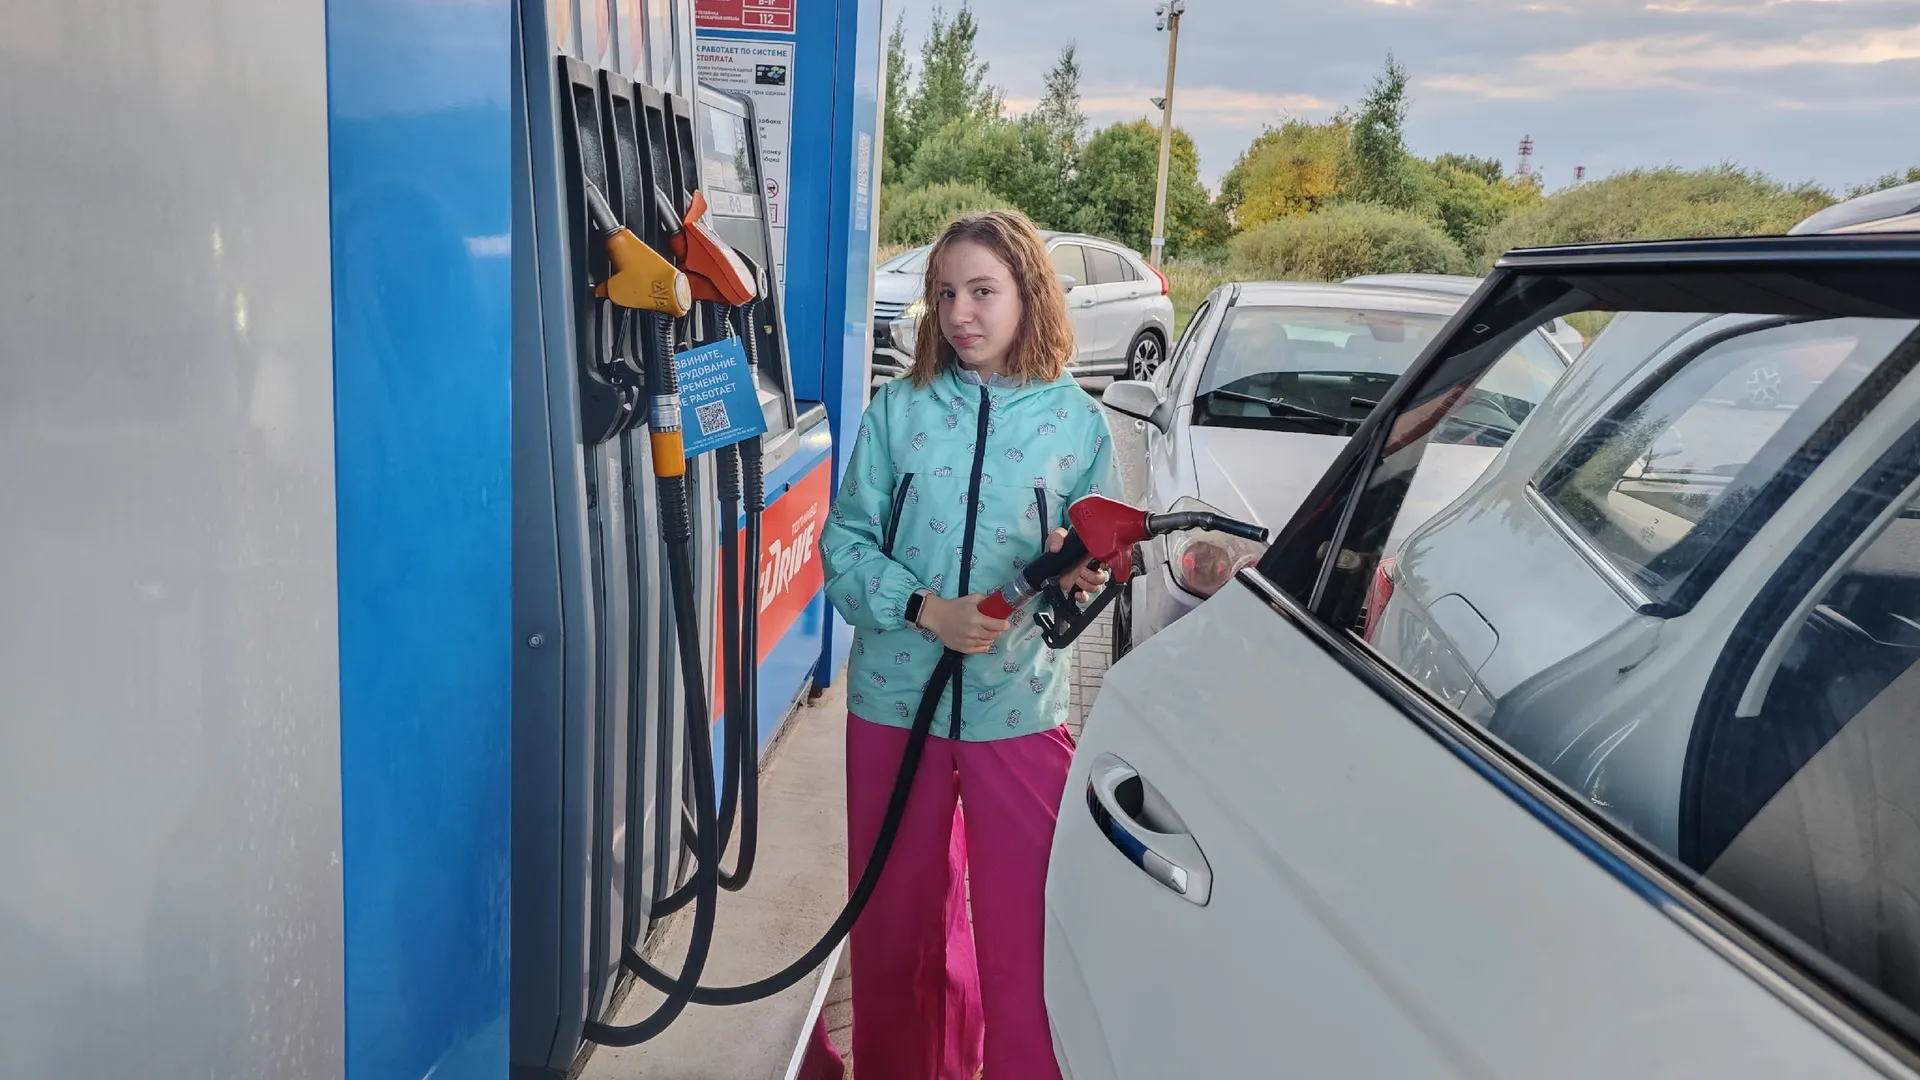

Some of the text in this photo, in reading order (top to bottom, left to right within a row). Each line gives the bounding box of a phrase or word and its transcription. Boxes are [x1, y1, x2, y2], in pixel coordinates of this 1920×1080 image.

[759, 13, 774, 24] 112
[701, 45, 739, 55] РАБОТАЕТ
[740, 47, 751, 55] ПО
[752, 48, 788, 57] СИСТЕМЕ
[689, 382, 737, 404] РАБОТАЕТ
